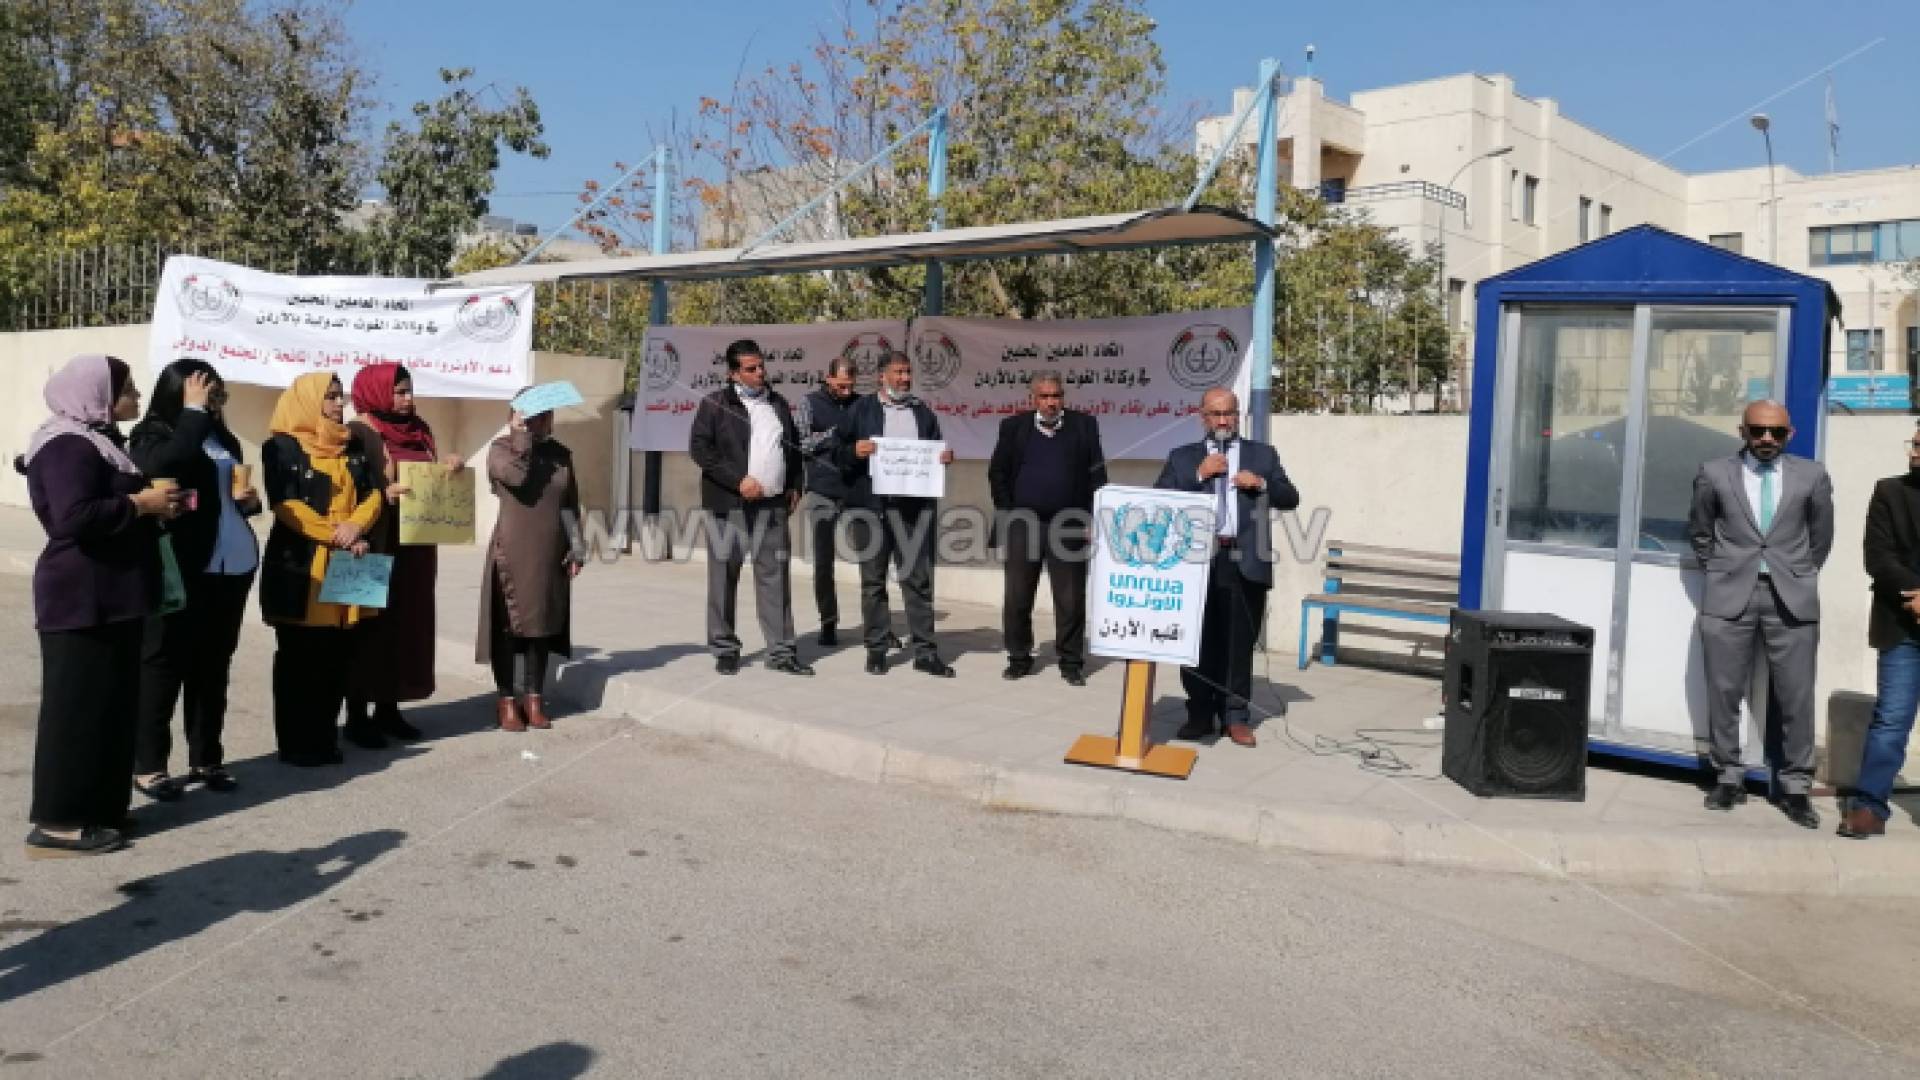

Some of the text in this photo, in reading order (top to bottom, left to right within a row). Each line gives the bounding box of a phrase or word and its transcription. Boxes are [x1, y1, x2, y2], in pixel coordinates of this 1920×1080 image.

[335, 296, 379, 311] العاملين
[384, 293, 413, 311] اتحاد
[1046, 341, 1089, 362] العاملين
[1093, 341, 1124, 357] اتحاد
[974, 366, 1017, 389] بالأردن
[1066, 369, 1100, 389] الغوث
[1104, 366, 1135, 389] وكالة
[1109, 572, 1184, 594] unrwa
